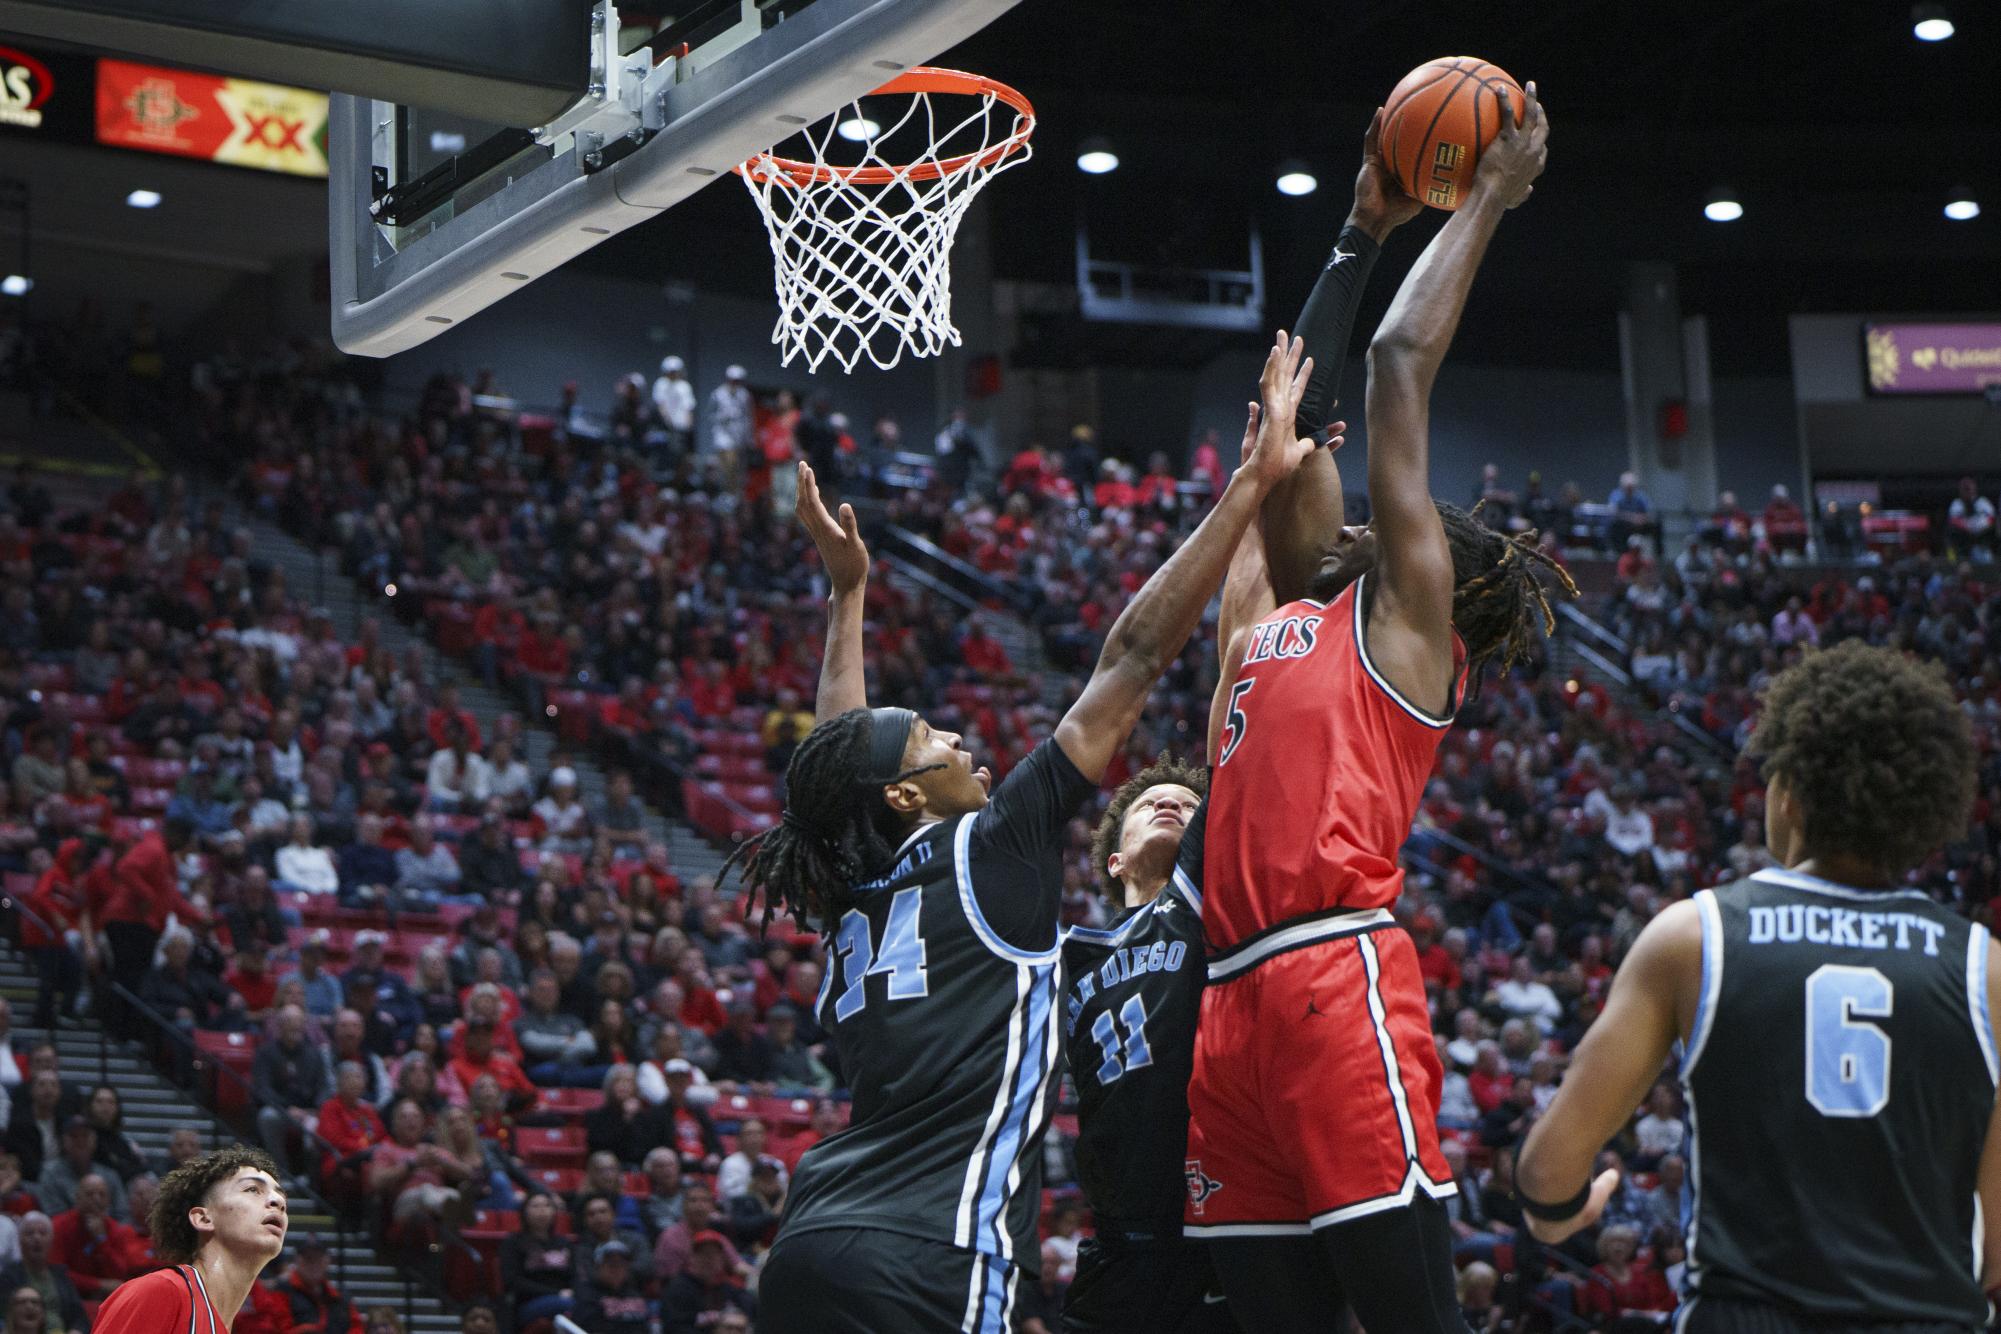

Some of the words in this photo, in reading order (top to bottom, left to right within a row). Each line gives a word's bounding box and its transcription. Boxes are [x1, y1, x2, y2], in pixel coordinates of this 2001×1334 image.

[1219, 676, 1257, 768] 5
[835, 885, 928, 1024] 24
[1100, 940, 1188, 989] DIEGO
[1748, 904, 1946, 957] DUCKETT
[1091, 992, 1154, 1087] 11
[1804, 963, 1894, 1118] 6
